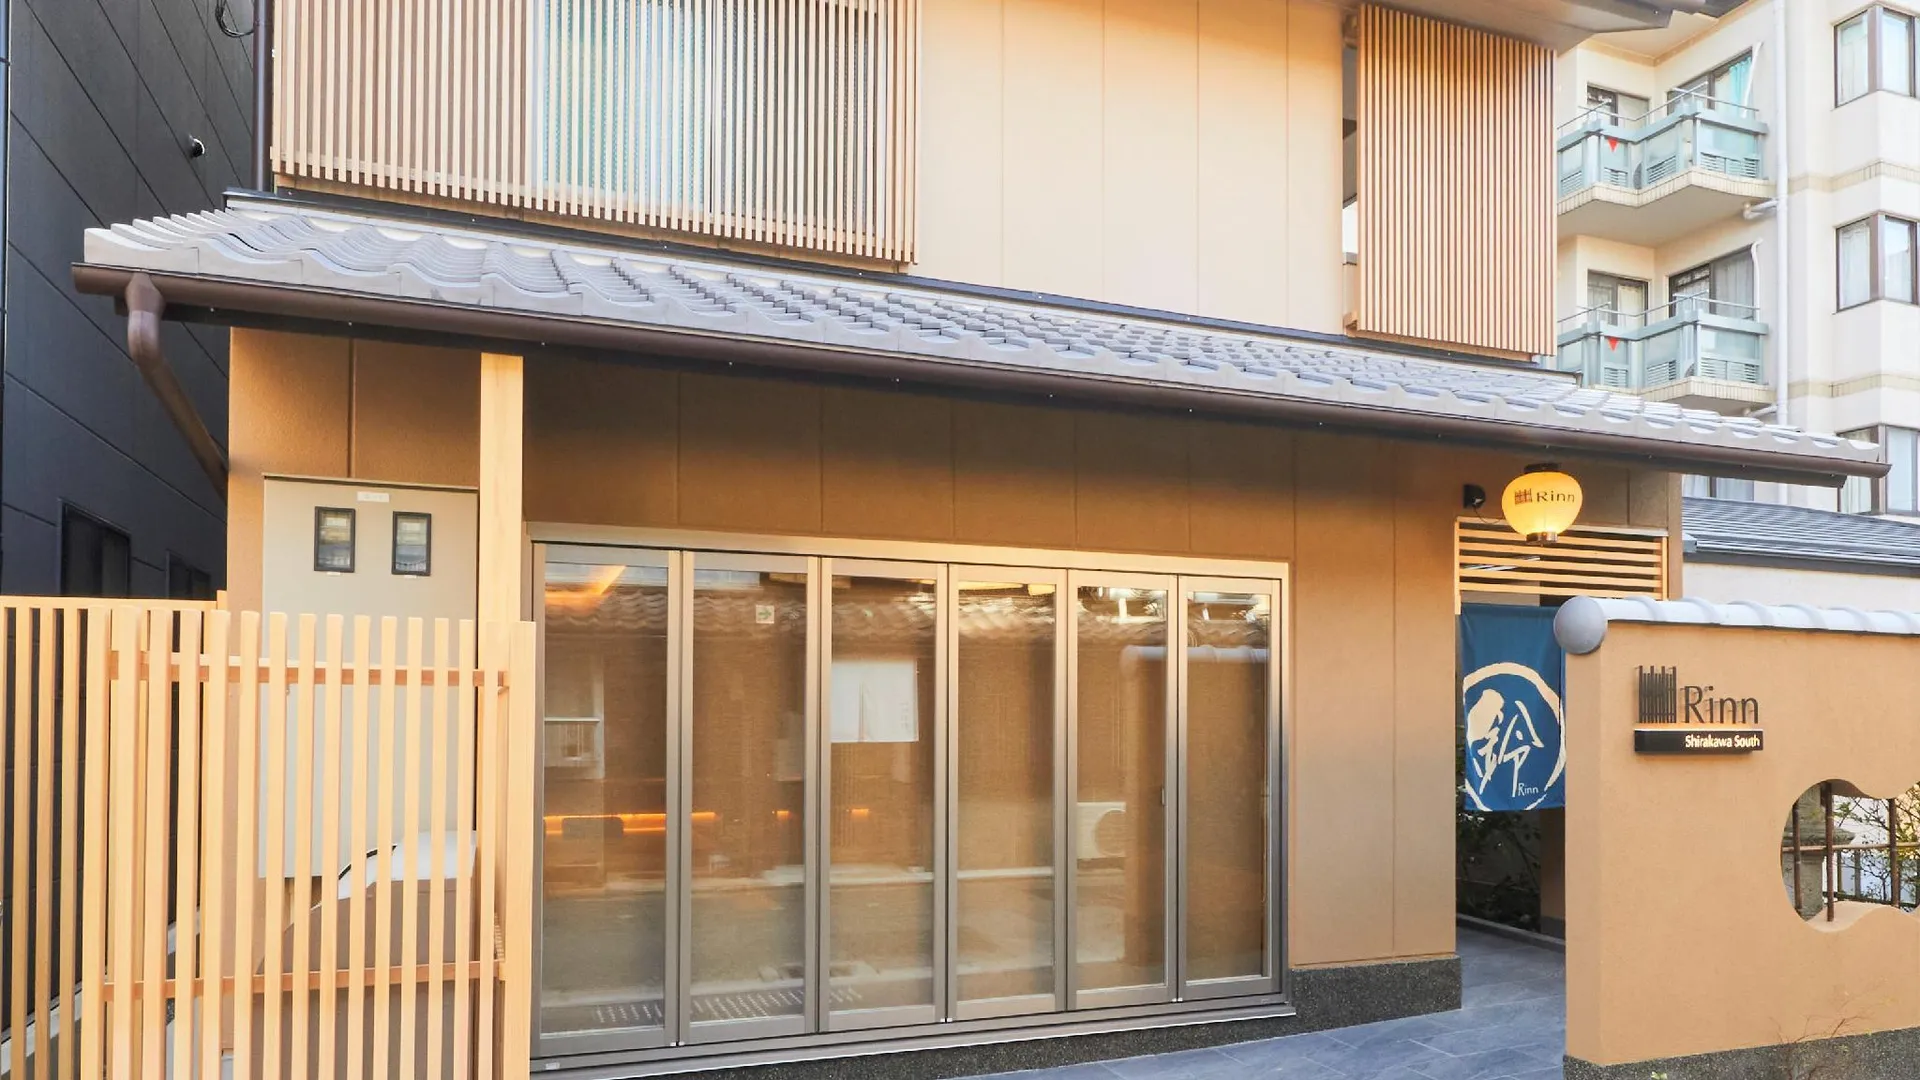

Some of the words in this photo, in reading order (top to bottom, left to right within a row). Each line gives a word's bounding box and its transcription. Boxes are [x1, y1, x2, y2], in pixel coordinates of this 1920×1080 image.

[1536, 490, 1575, 503] Rinn
[1684, 685, 1759, 724] Rinn
[1685, 734, 1733, 748] Shirakawa
[1734, 734, 1761, 748] South
[1518, 782, 1539, 796] Rinn
